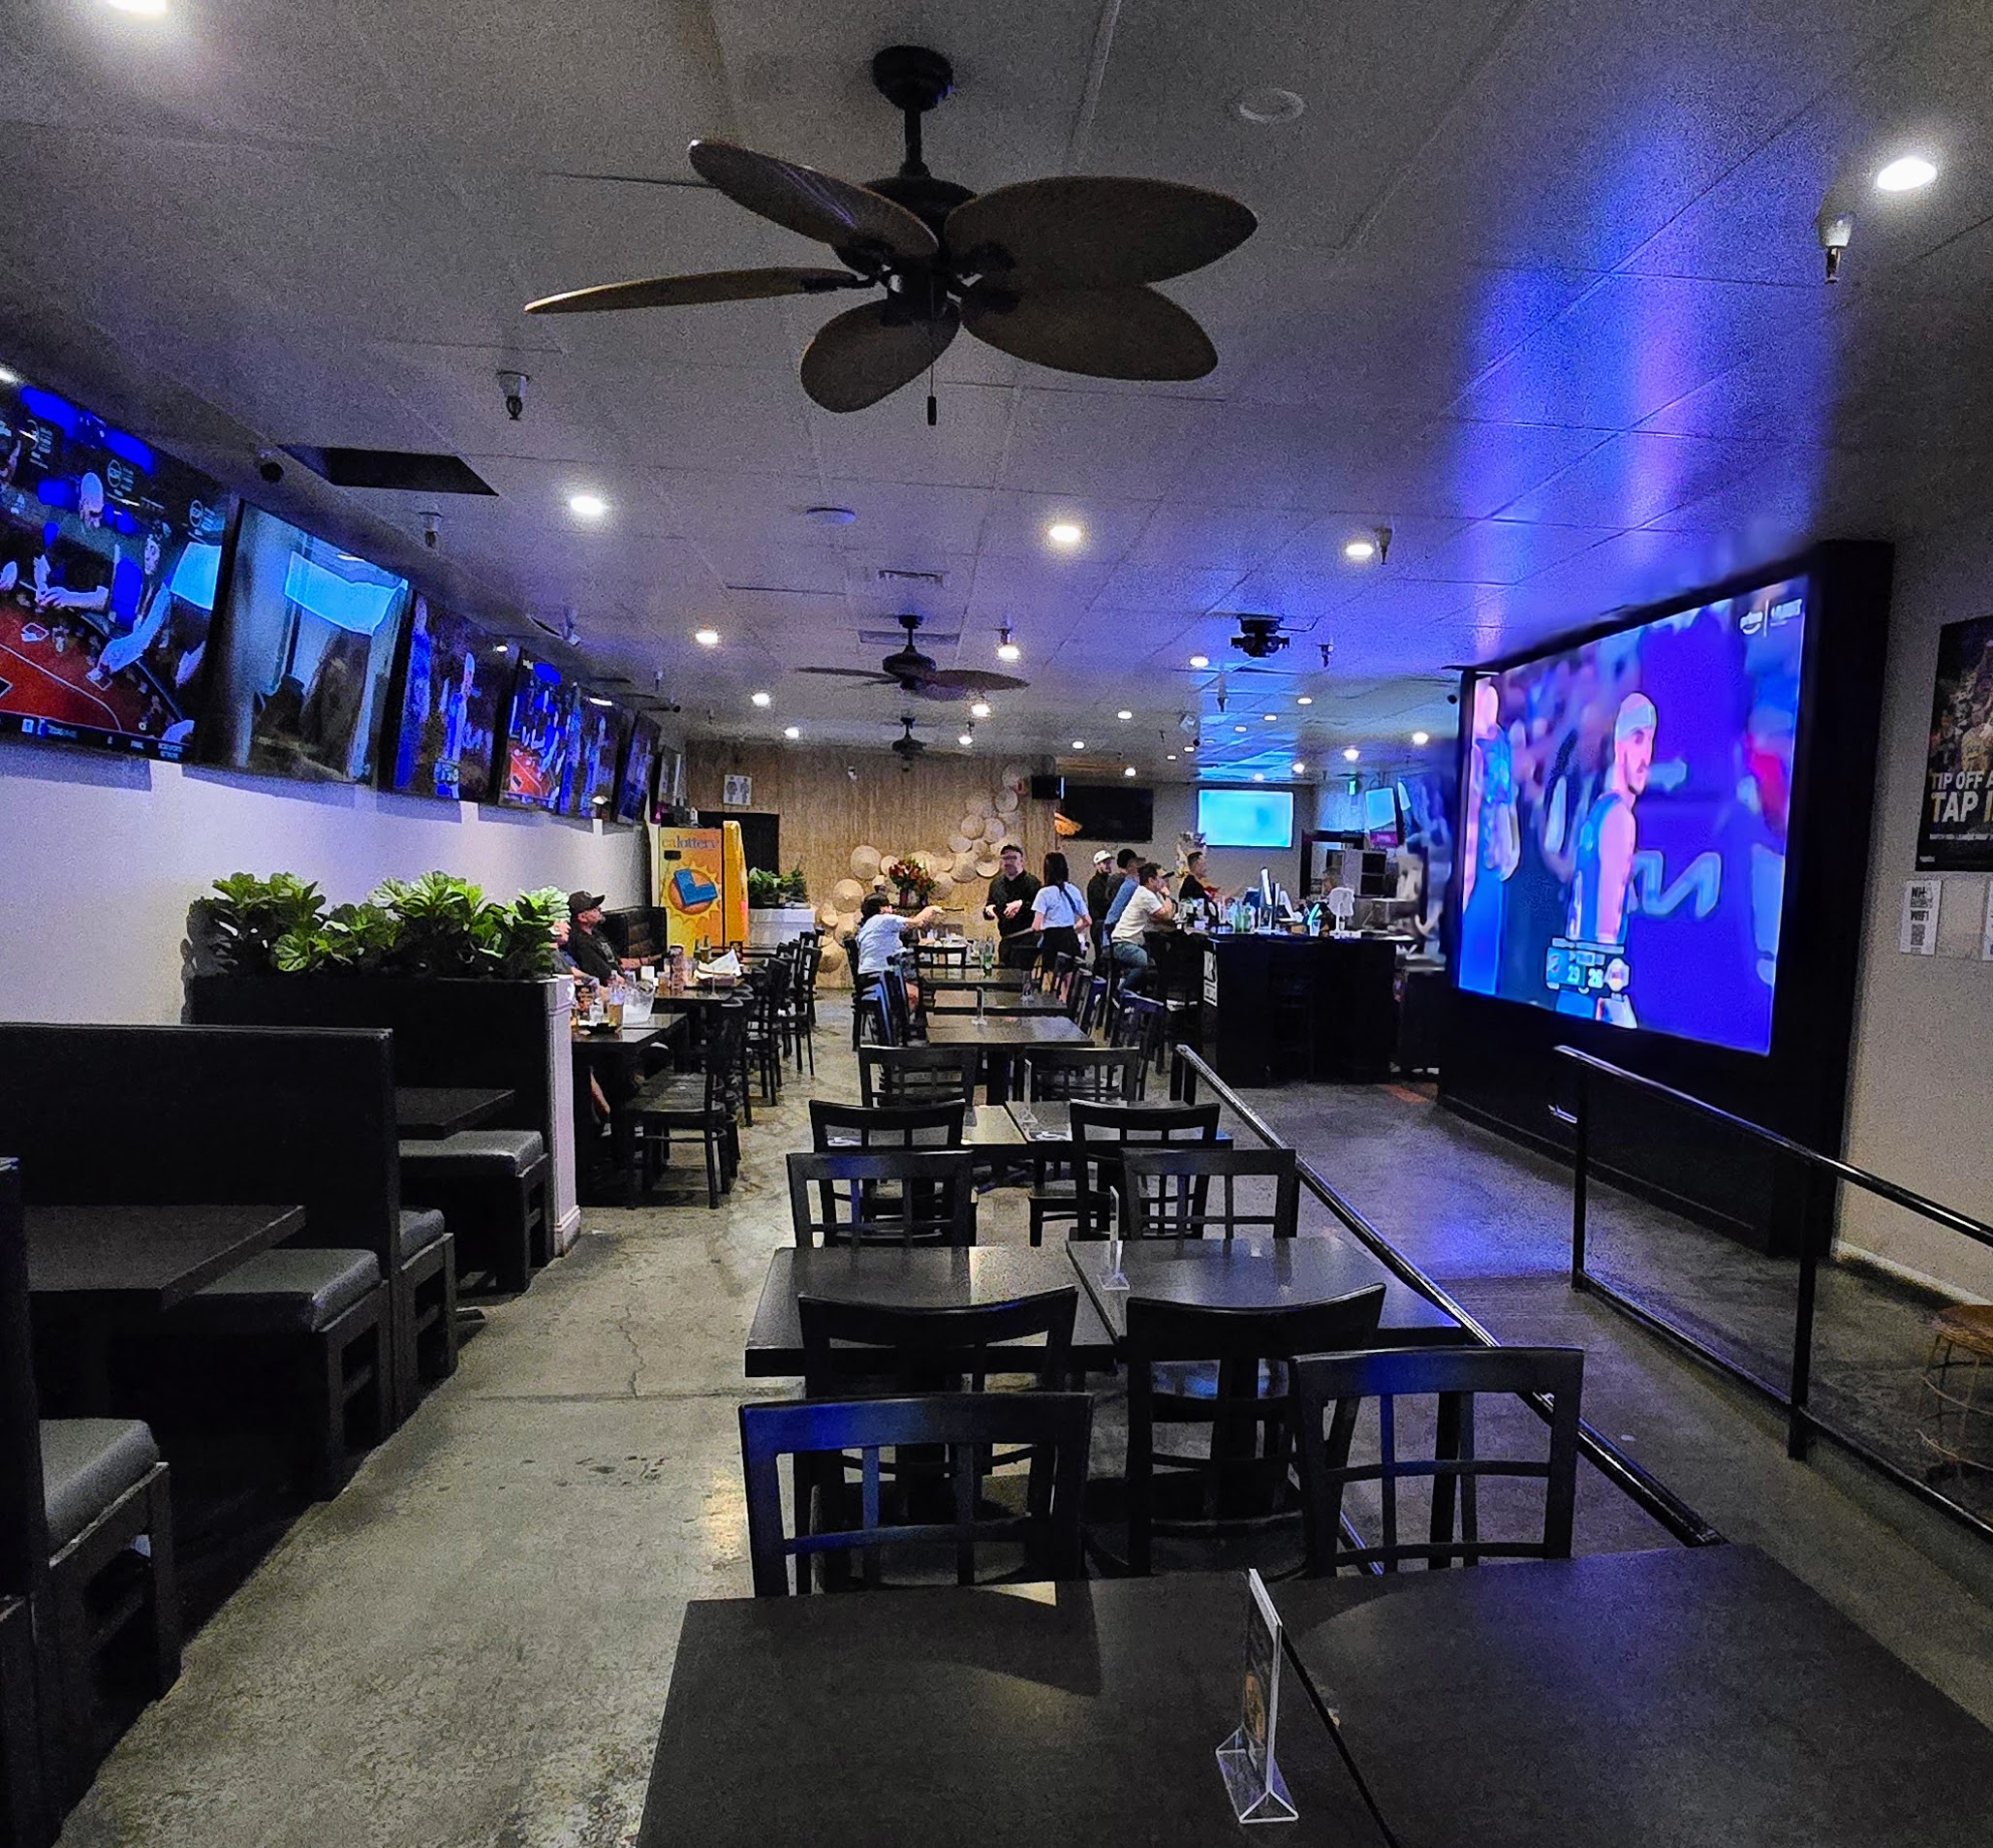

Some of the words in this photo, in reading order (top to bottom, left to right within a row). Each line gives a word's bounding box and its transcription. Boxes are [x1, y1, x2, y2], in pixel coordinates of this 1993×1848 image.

[1931, 772, 1953, 790] TIP
[1956, 771, 1983, 790] OFF
[1931, 791, 1978, 823] TAP
